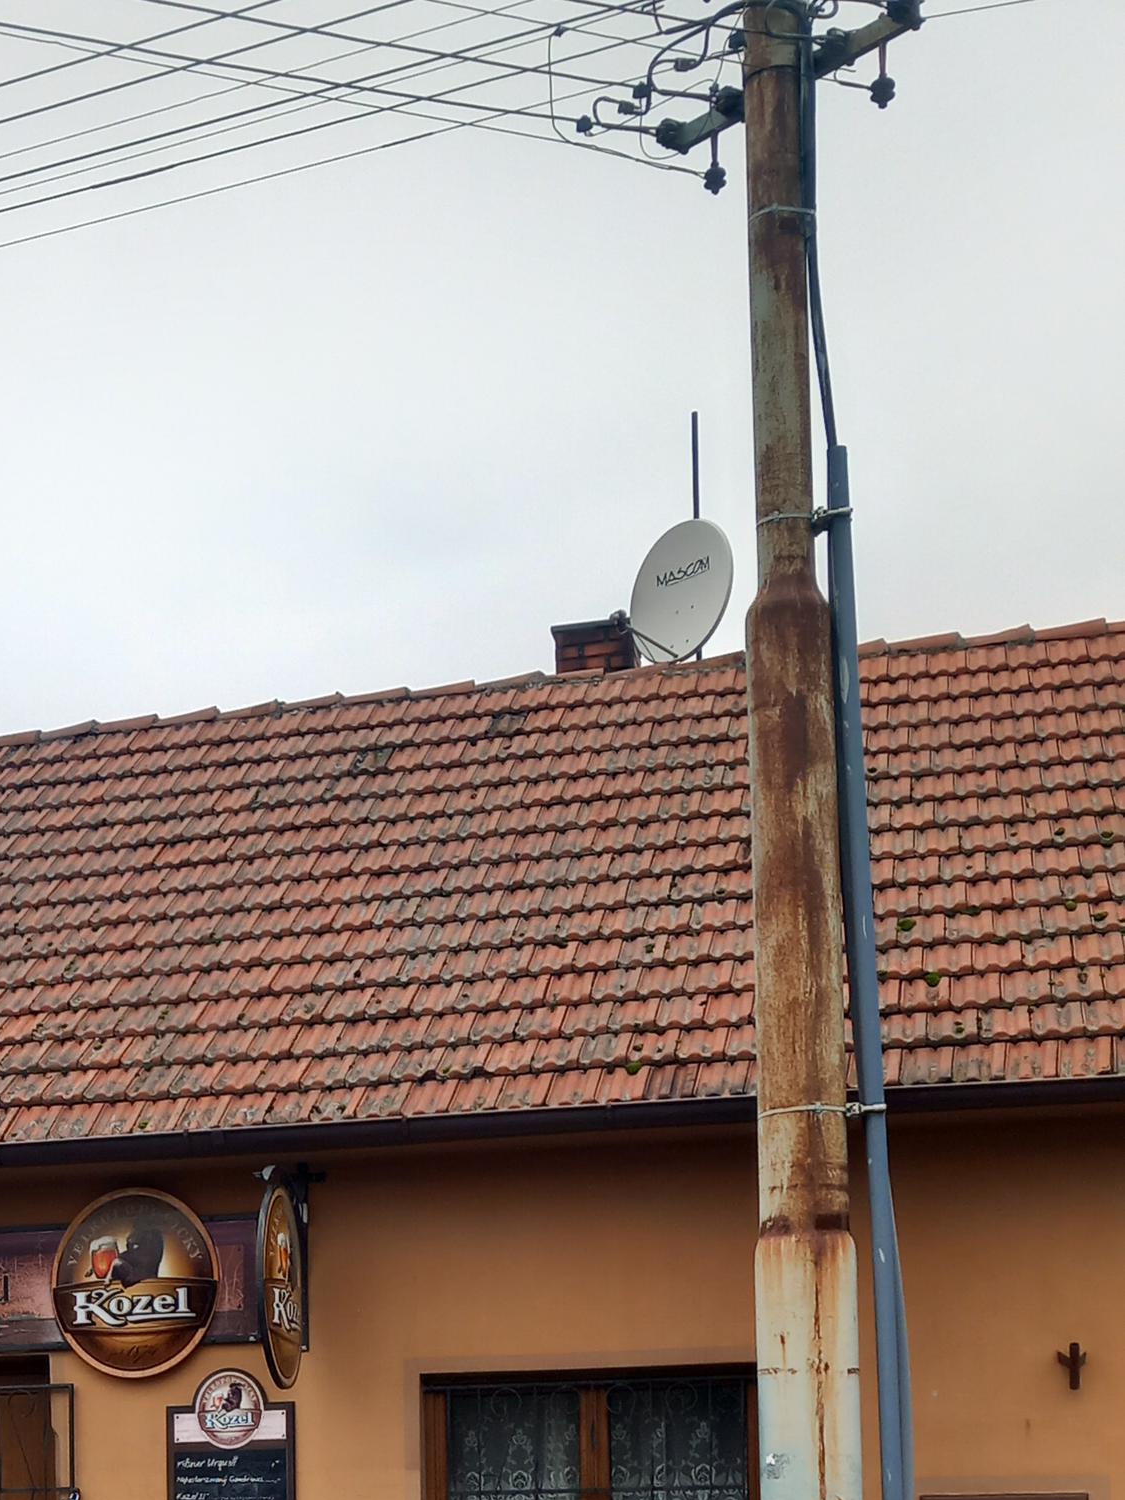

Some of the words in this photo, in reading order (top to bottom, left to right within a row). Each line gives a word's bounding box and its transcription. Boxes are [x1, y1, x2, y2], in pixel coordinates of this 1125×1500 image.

[656, 555, 710, 587] MASCOM
[72, 1286, 196, 1326] Kozel
[272, 1287, 301, 1330] Koz
[205, 1411, 255, 1429] Kozel
